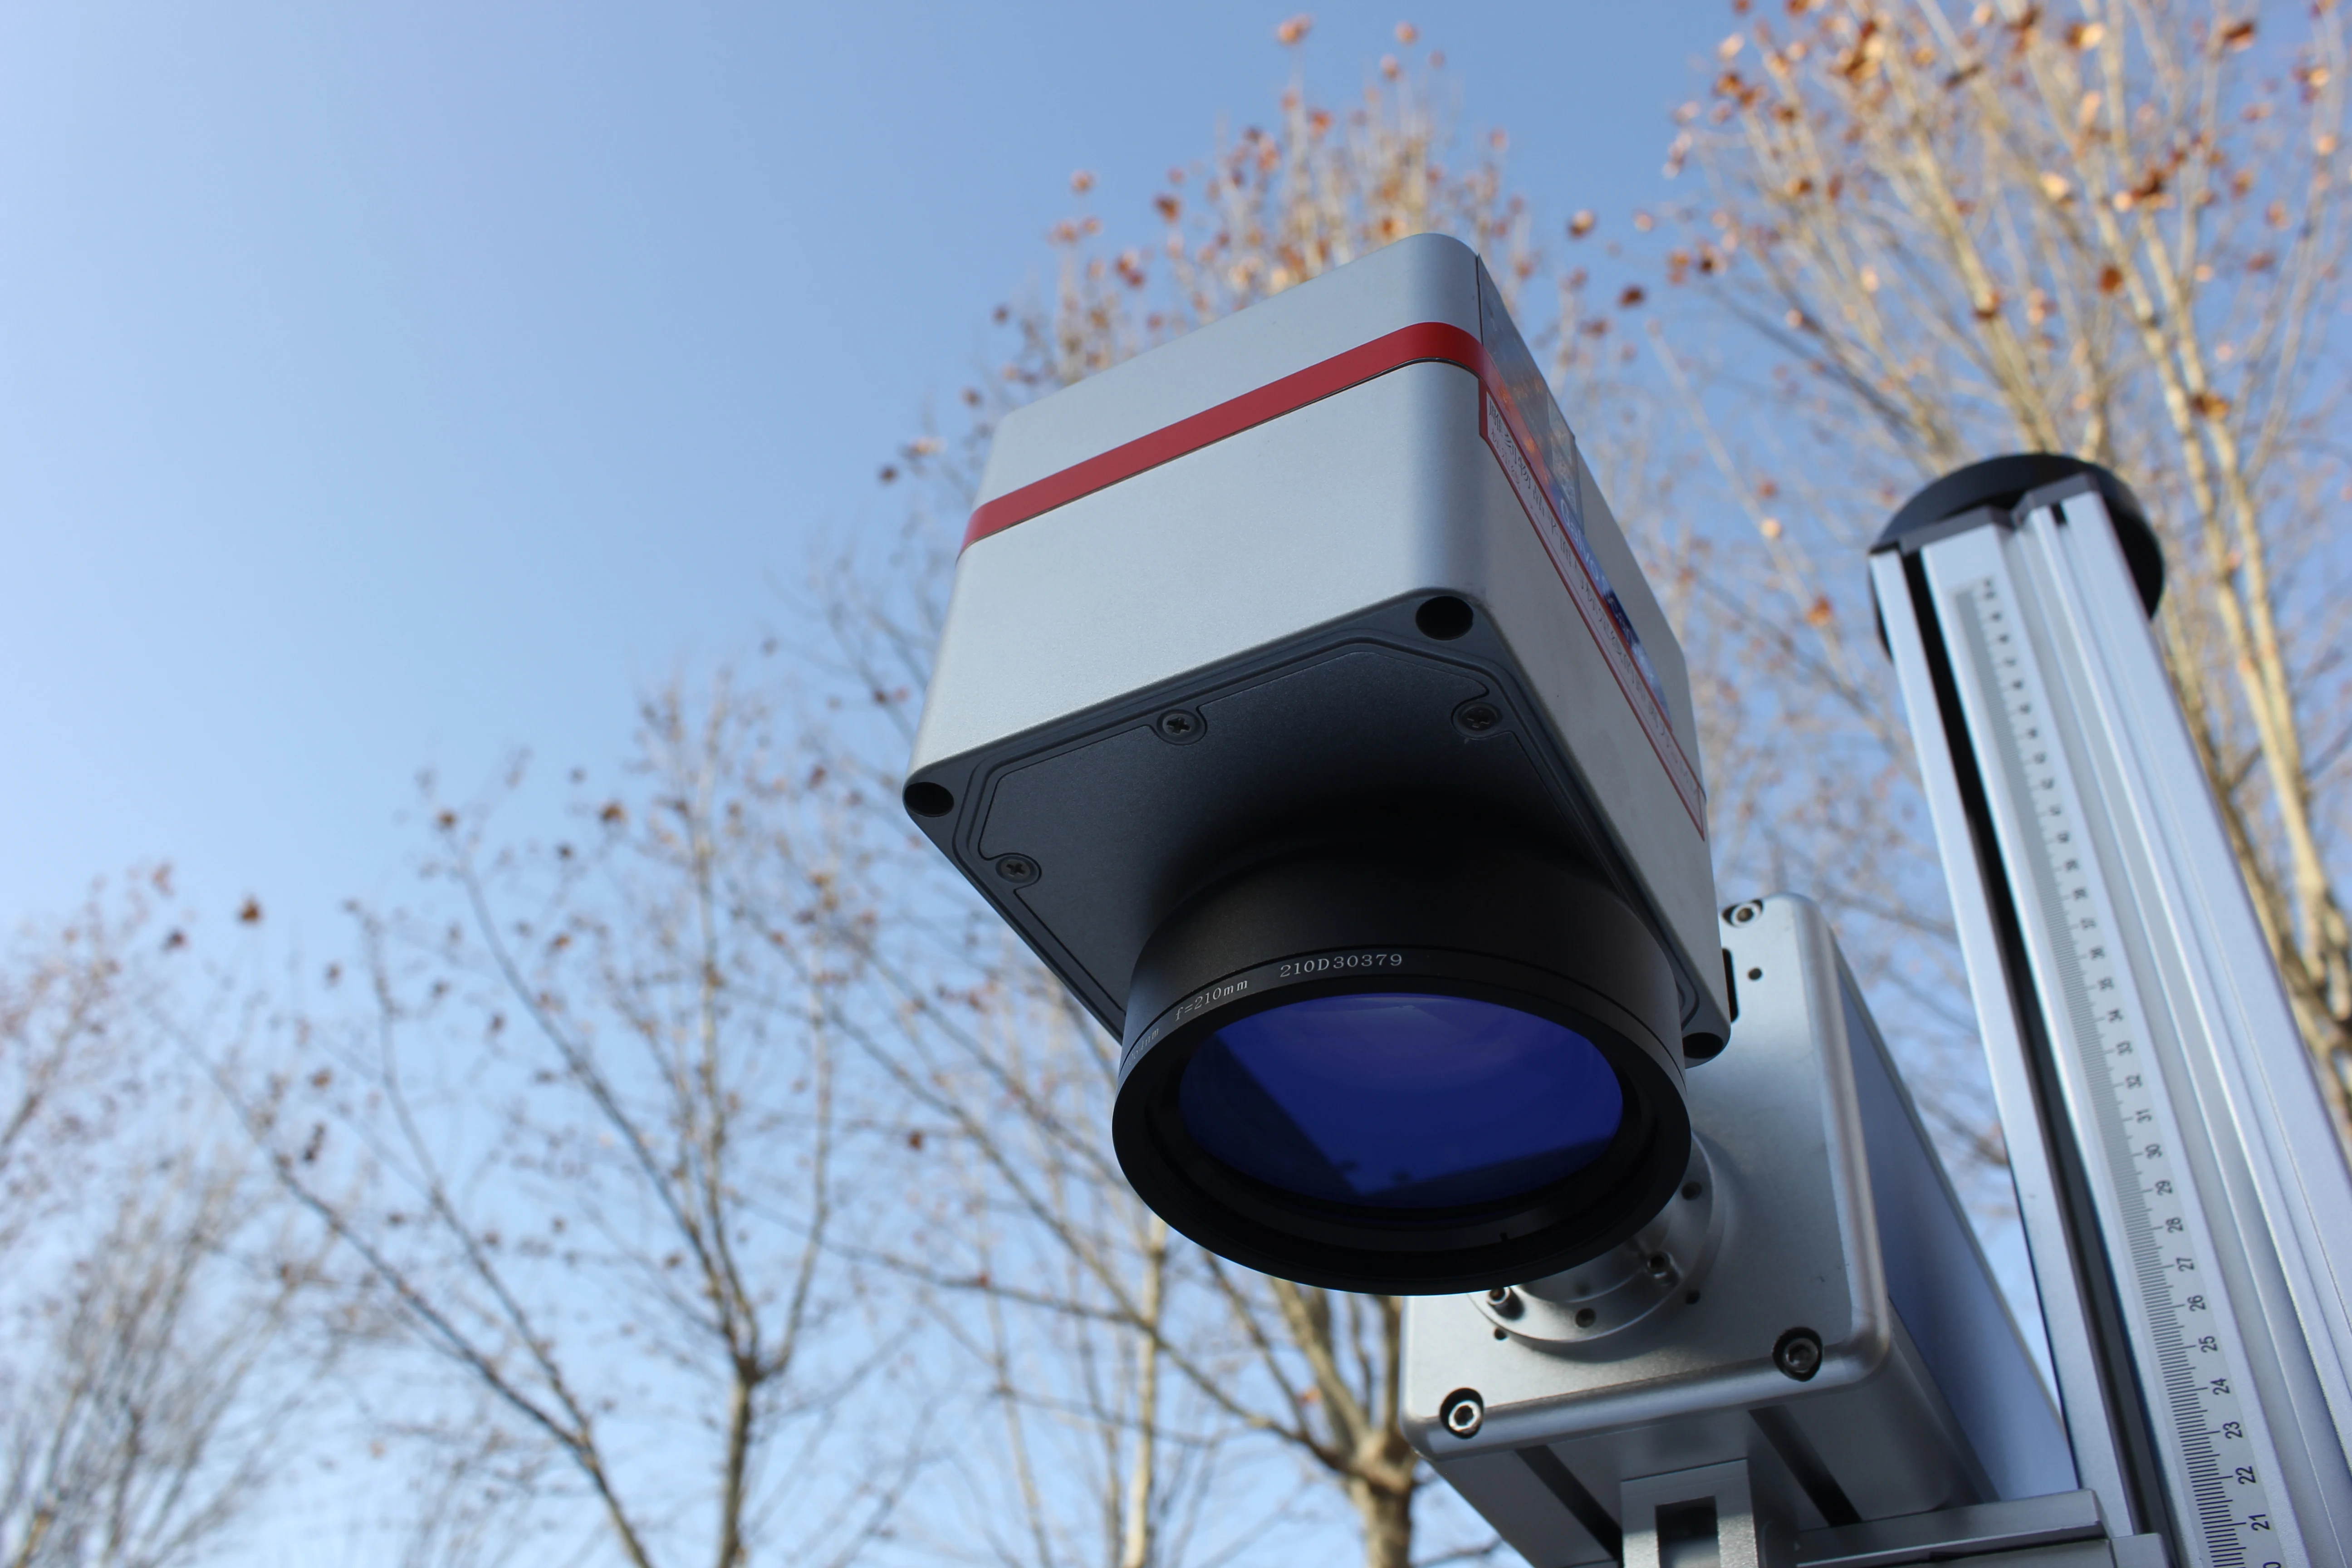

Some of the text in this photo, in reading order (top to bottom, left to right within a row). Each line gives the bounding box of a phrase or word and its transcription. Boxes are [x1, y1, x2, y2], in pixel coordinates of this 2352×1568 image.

[1561, 498, 1599, 581] Galvo
[1175, 979, 1248, 1022] f=210mm
[1280, 954, 1403, 977] 210D30379
[2099, 978, 2113, 990] 35
[2108, 1009, 2124, 1023] 34
[2117, 1042, 2132, 1054] 33
[2126, 1075, 2141, 1088] 32
[2136, 1110, 2151, 1122] 31
[2146, 1144, 2162, 1158] 30
[2156, 1180, 2173, 1196] 29
[2166, 1217, 2184, 1233] 28
[2177, 1257, 2195, 1272] 27
[2188, 1295, 2206, 1312] 26
[2200, 1336, 2218, 1352] 25
[2212, 1378, 2230, 1395] 24
[2224, 1421, 2243, 1439] 23
[2236, 1466, 2256, 1485] 22
[2250, 1514, 2271, 1531] 21
